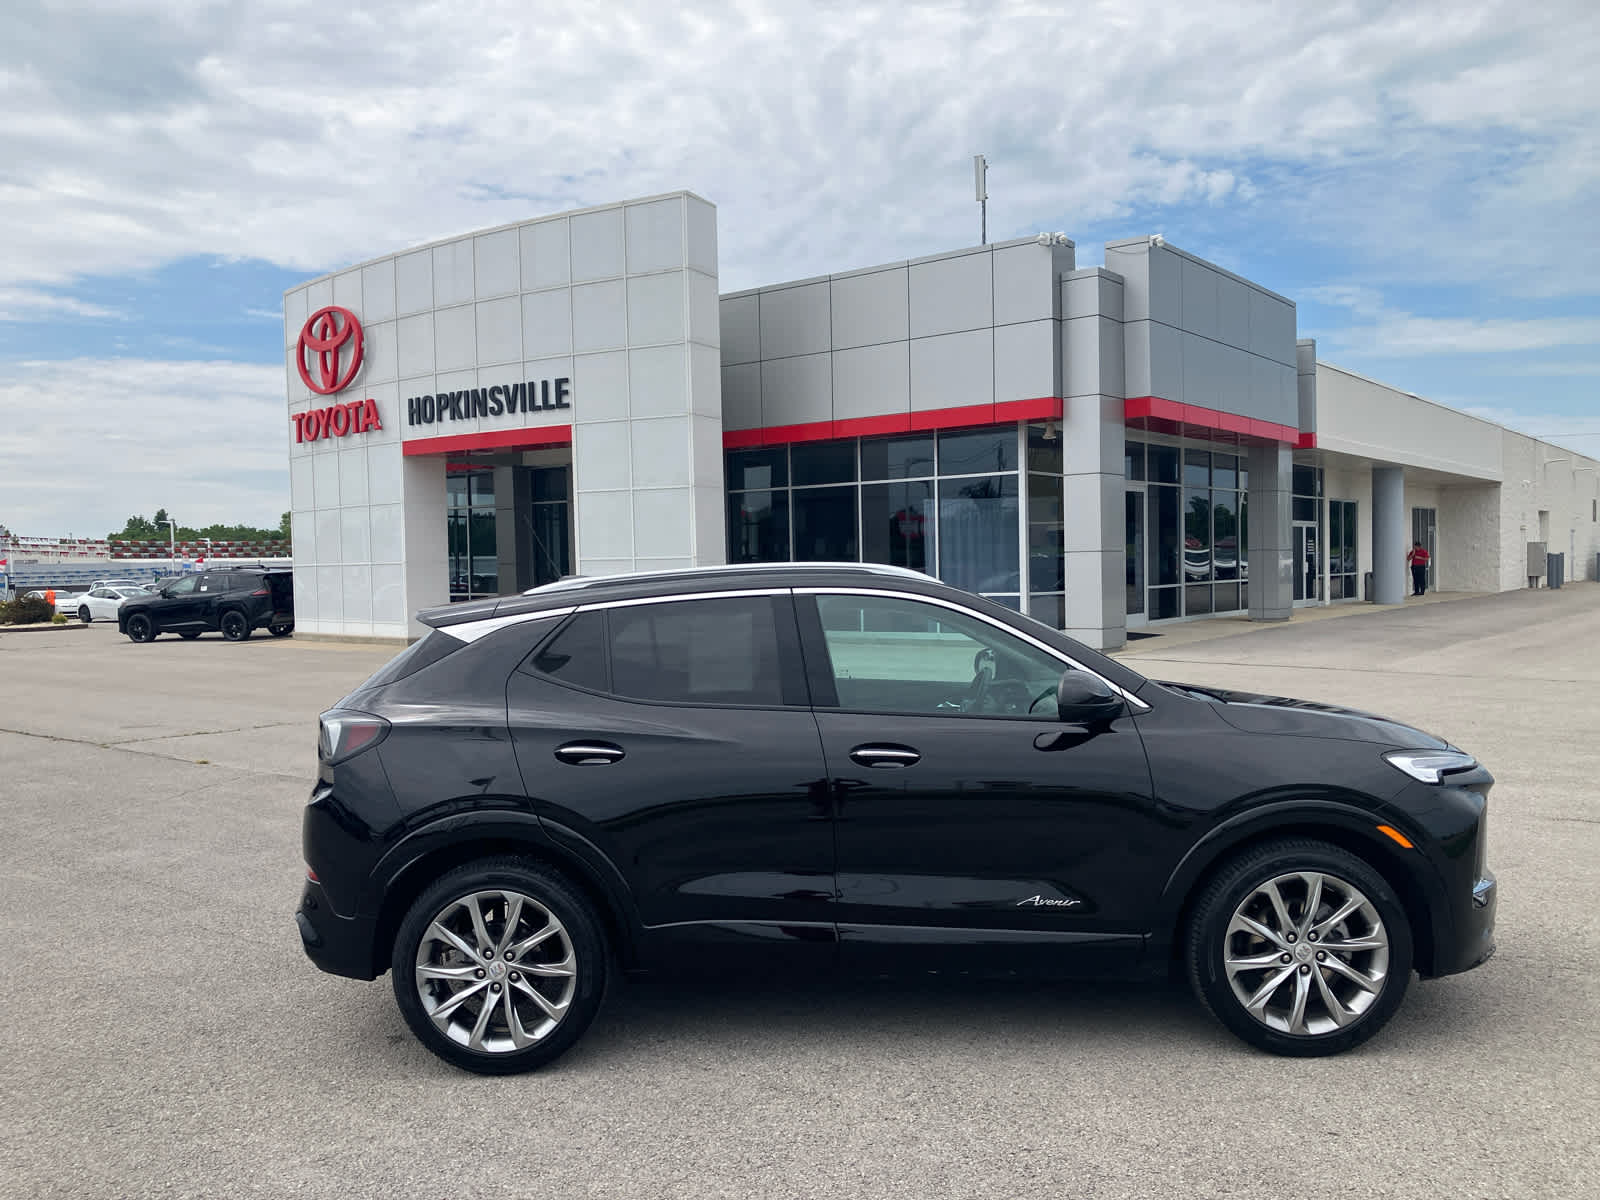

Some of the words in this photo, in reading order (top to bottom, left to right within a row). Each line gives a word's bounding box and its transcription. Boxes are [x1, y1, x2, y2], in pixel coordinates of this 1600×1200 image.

[292, 398, 383, 443] TOYOTA
[408, 377, 570, 426] HOPKINSVILLE
[1016, 895, 1081, 906] Avenir
